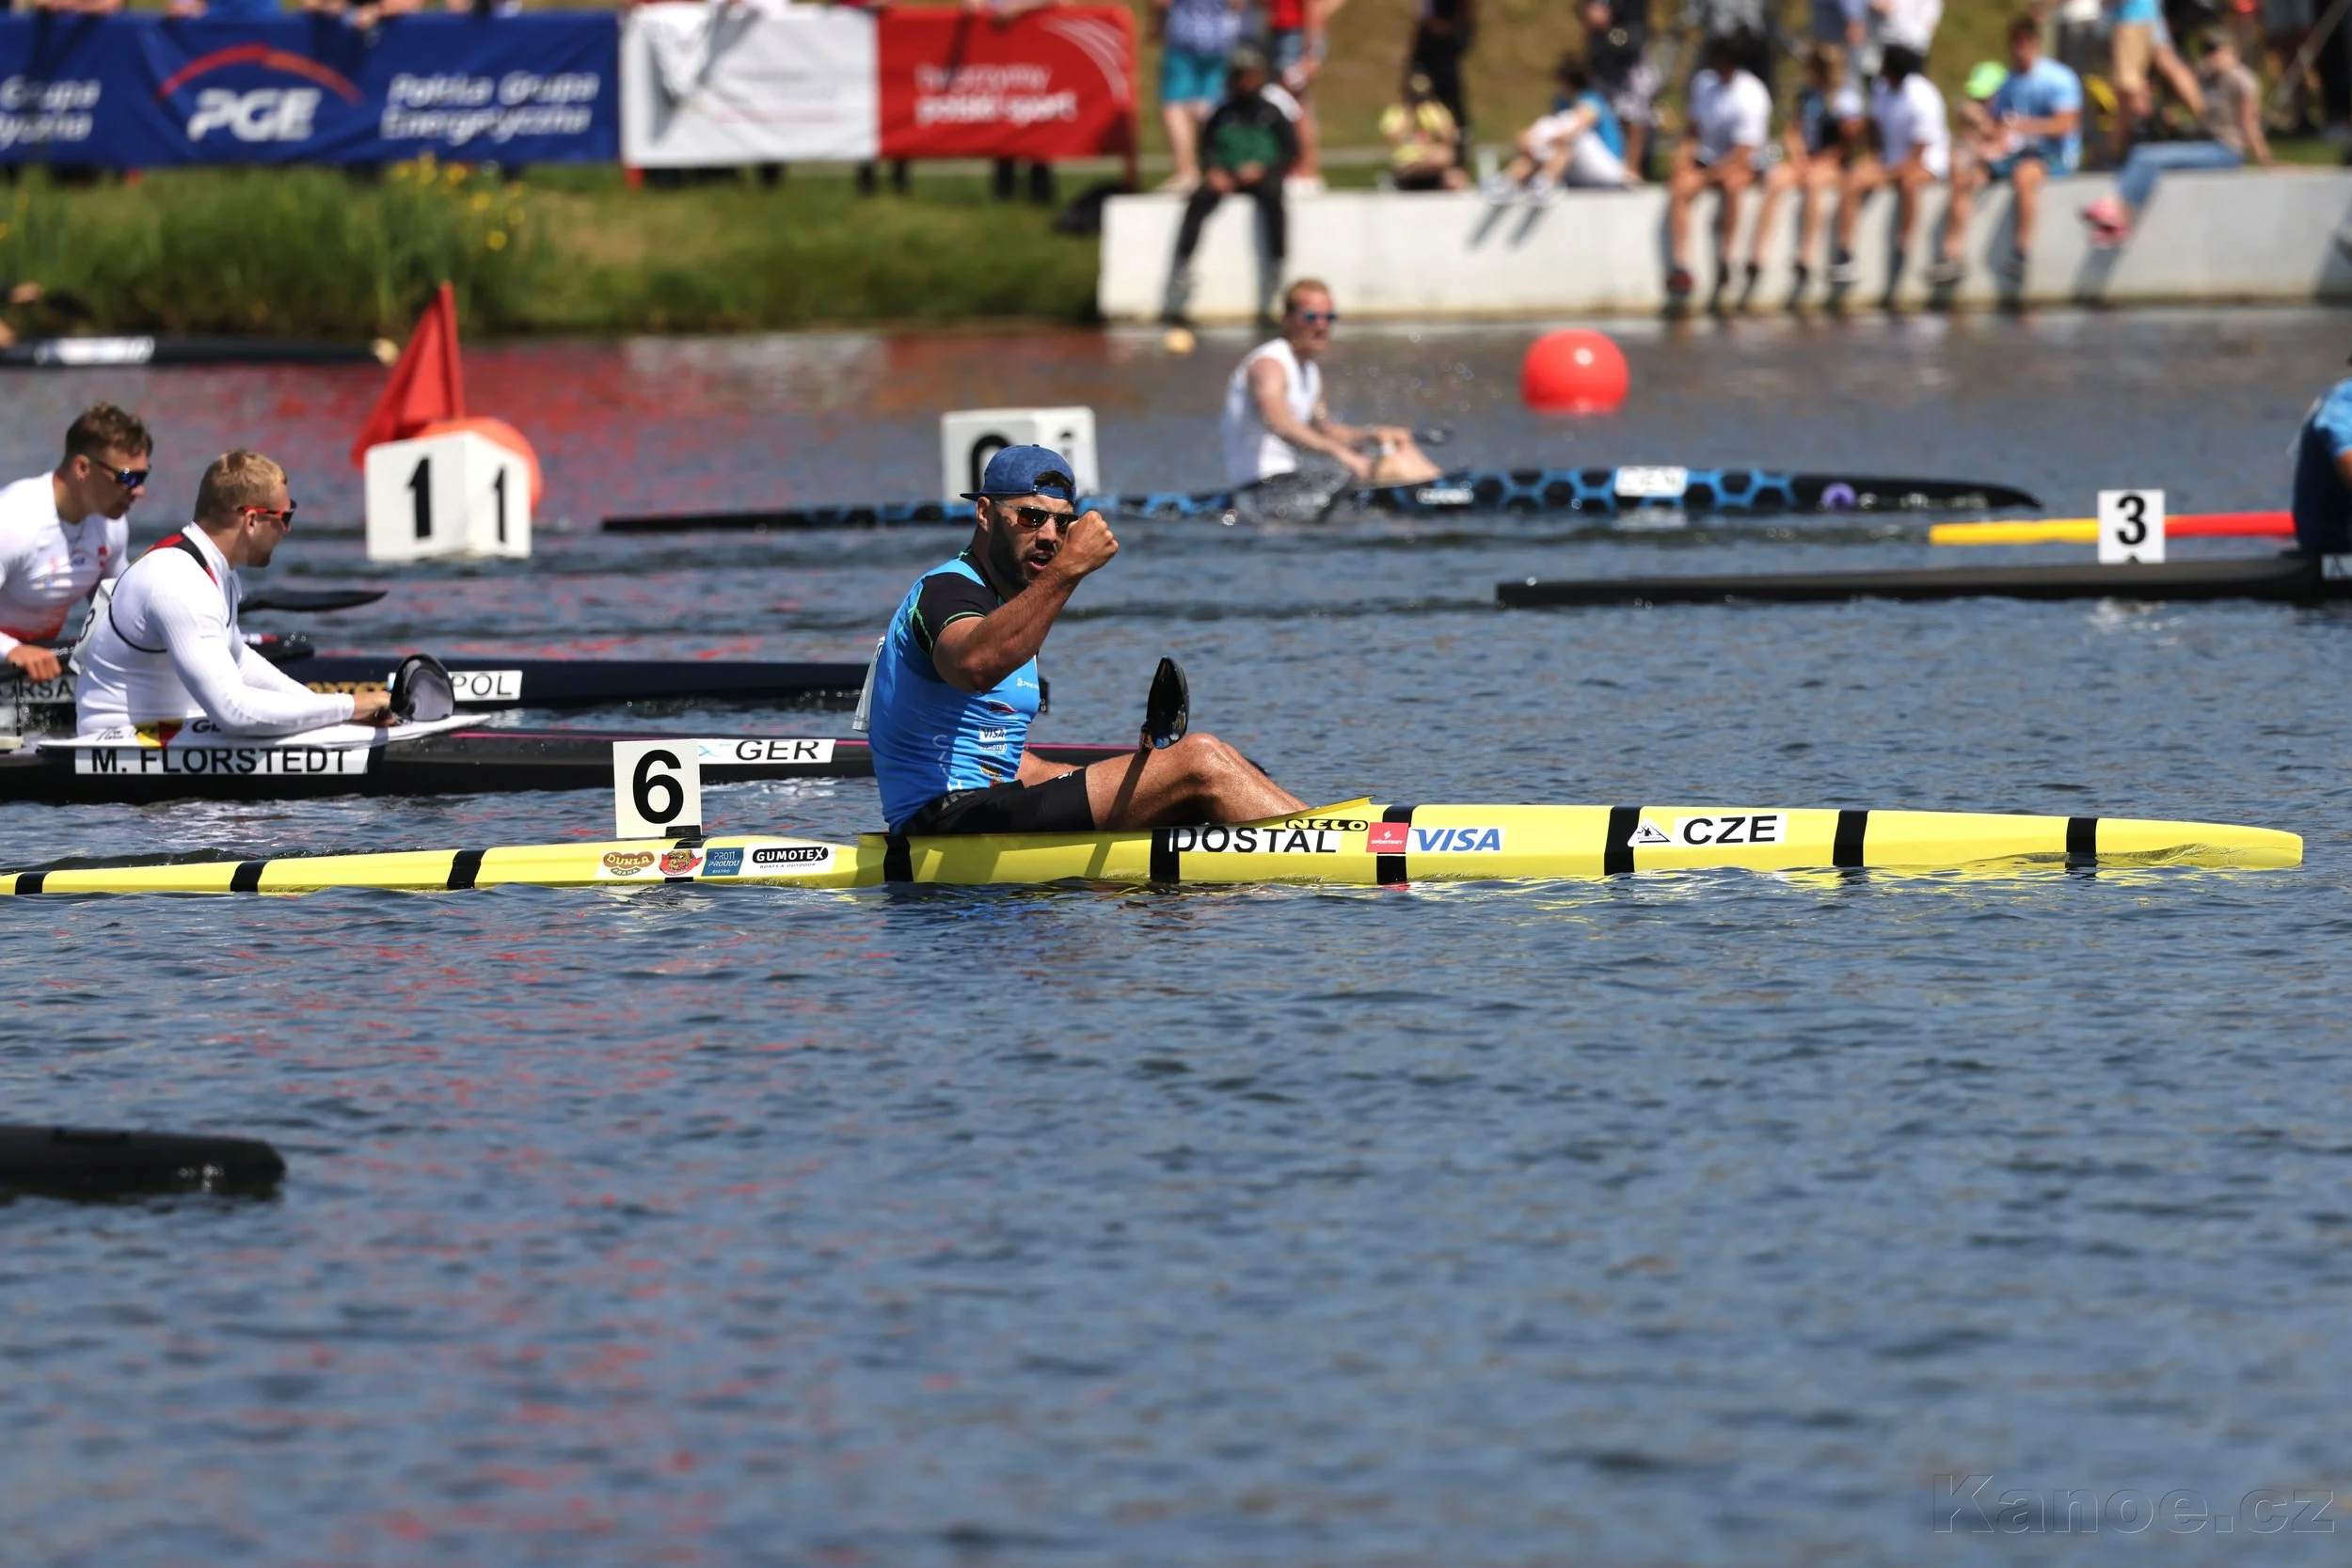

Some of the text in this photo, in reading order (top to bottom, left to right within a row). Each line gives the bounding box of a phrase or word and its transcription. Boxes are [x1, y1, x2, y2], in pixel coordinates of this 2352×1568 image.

[186, 87, 322, 142] PGE
[407, 455, 433, 540] 1
[493, 465, 507, 545] 1
[2116, 494, 2147, 546] 3
[451, 675, 513, 696] POL
[92, 748, 353, 773] M. FLORSTEDT
[736, 740, 819, 761] GER
[632, 749, 684, 824] 6
[1287, 819, 1367, 832] NELO
[1683, 816, 1777, 845] CZE
[1173, 825, 1337, 853] DOSTAL
[1413, 828, 1501, 851] VISA
[607, 854, 650, 865] DUKLA
[756, 847, 824, 862] GUMOTEX
